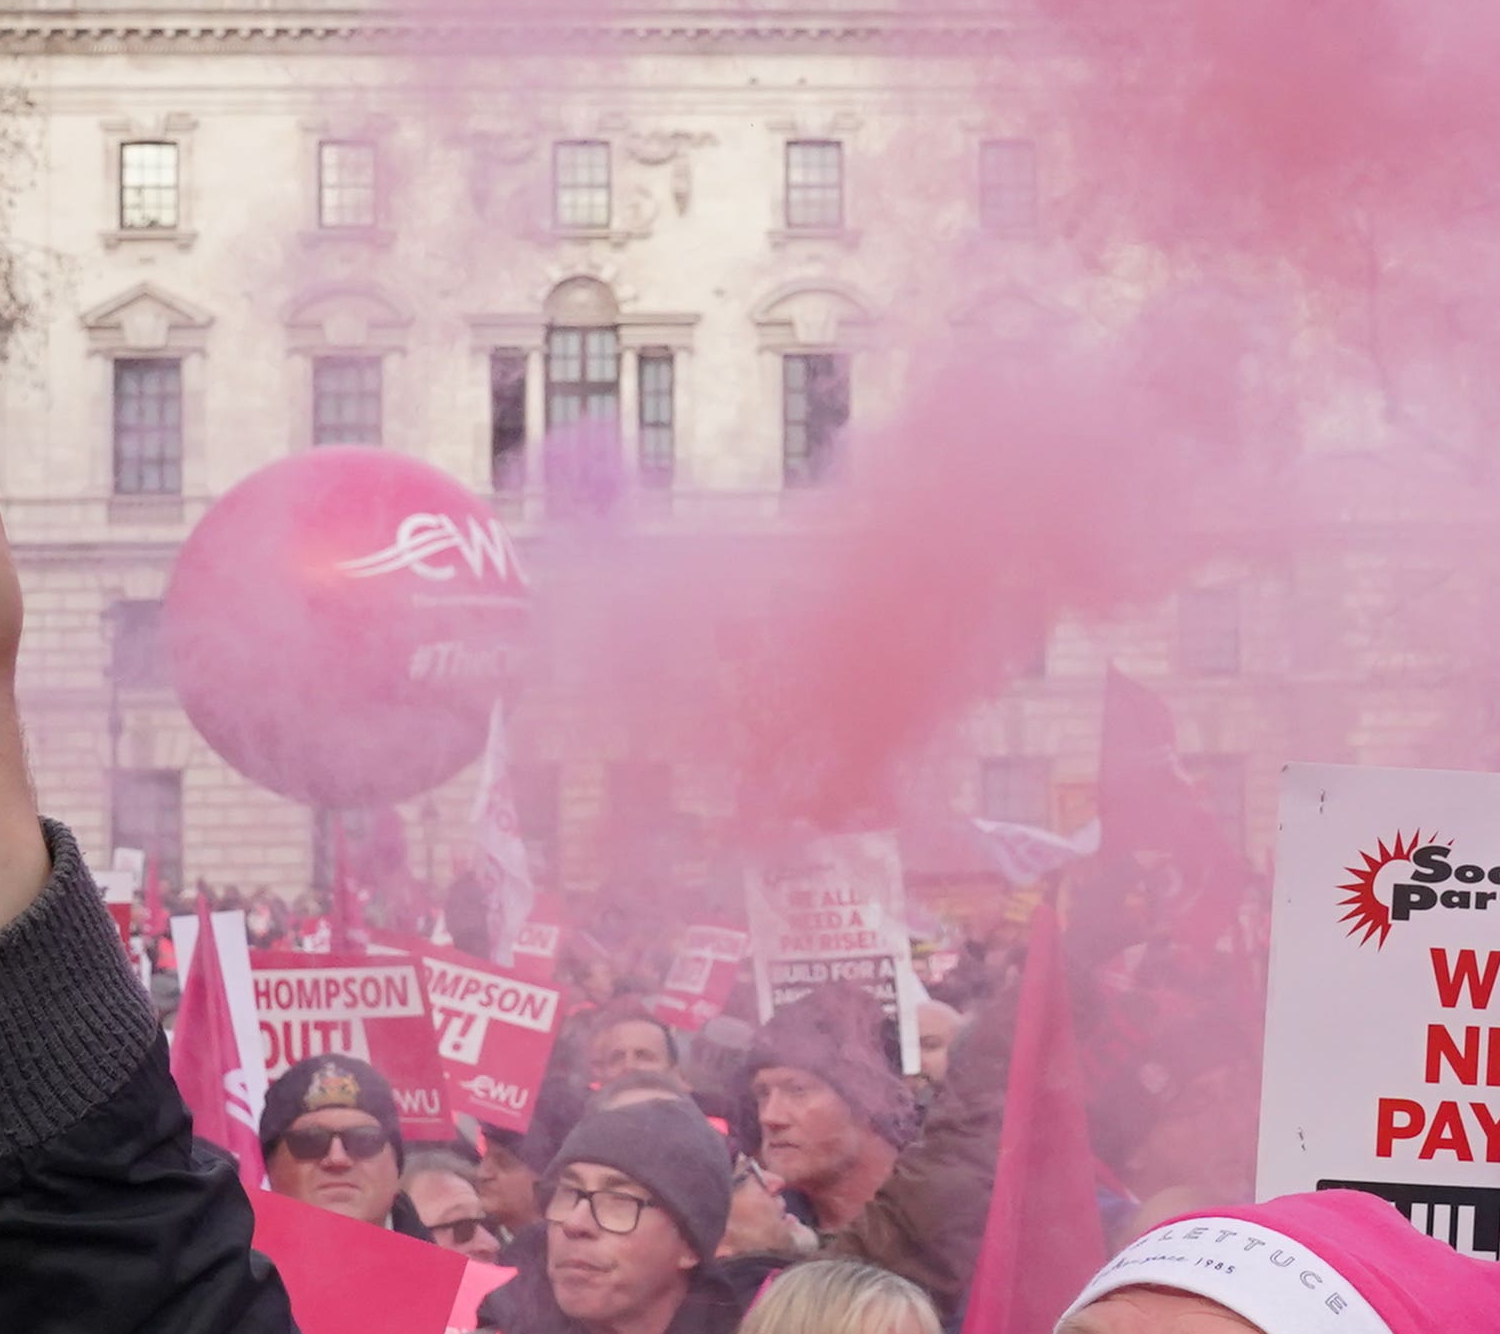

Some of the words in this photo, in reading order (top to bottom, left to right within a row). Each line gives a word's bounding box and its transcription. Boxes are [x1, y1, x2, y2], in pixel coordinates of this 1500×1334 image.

[823, 890, 860, 907] ALL
[818, 930, 879, 953] RISE!
[772, 961, 829, 984] BUILD
[830, 959, 876, 980] FOR
[254, 972, 410, 1009] HOMPSON
[436, 1005, 478, 1054] T!
[392, 1087, 441, 1115] WU
[458, 1074, 531, 1111] CWU
[1194, 1257, 1237, 1275] 1985
